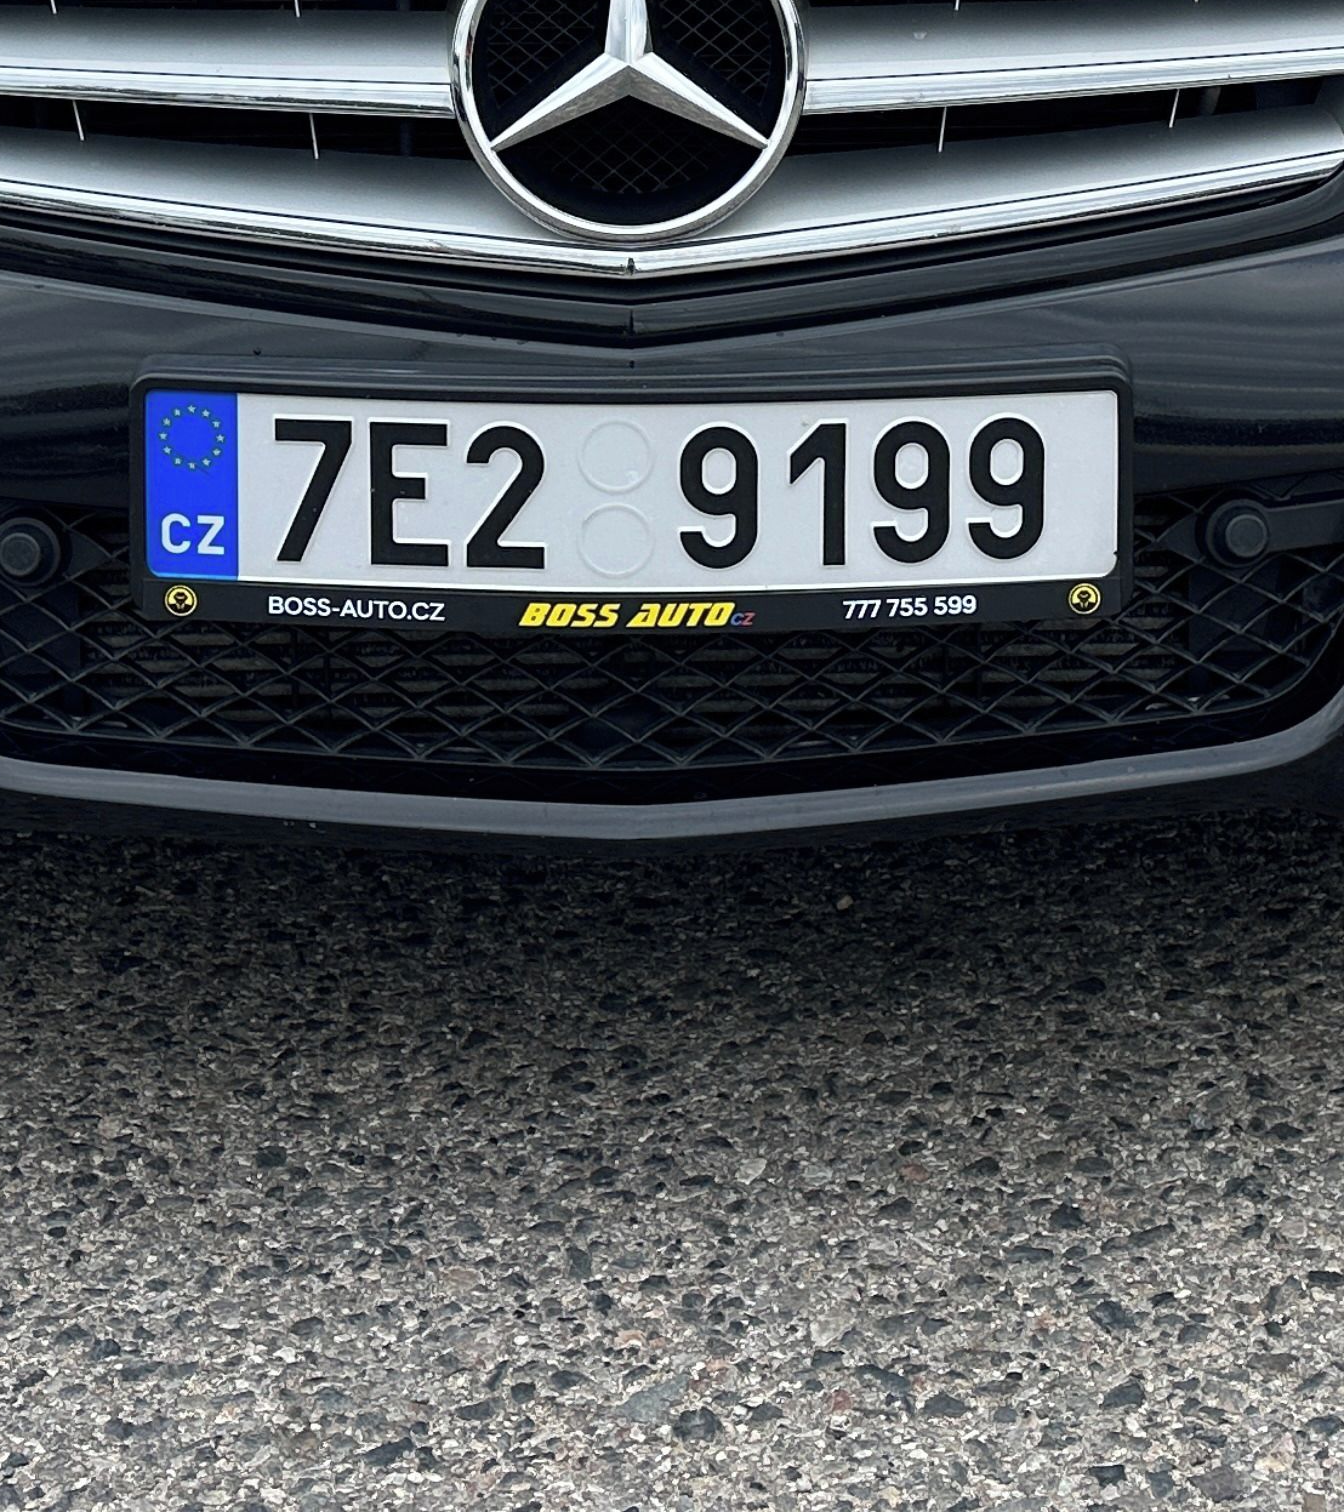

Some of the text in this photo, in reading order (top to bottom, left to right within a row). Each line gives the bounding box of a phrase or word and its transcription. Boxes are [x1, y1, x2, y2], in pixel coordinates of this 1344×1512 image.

[274, 416, 1046, 570] 7E2 9199
[161, 512, 225, 555] CZ
[268, 595, 446, 622] BOSS-AUTO.CZ
[518, 602, 621, 628] BOSS
[842, 594, 978, 620] 777 755 599
